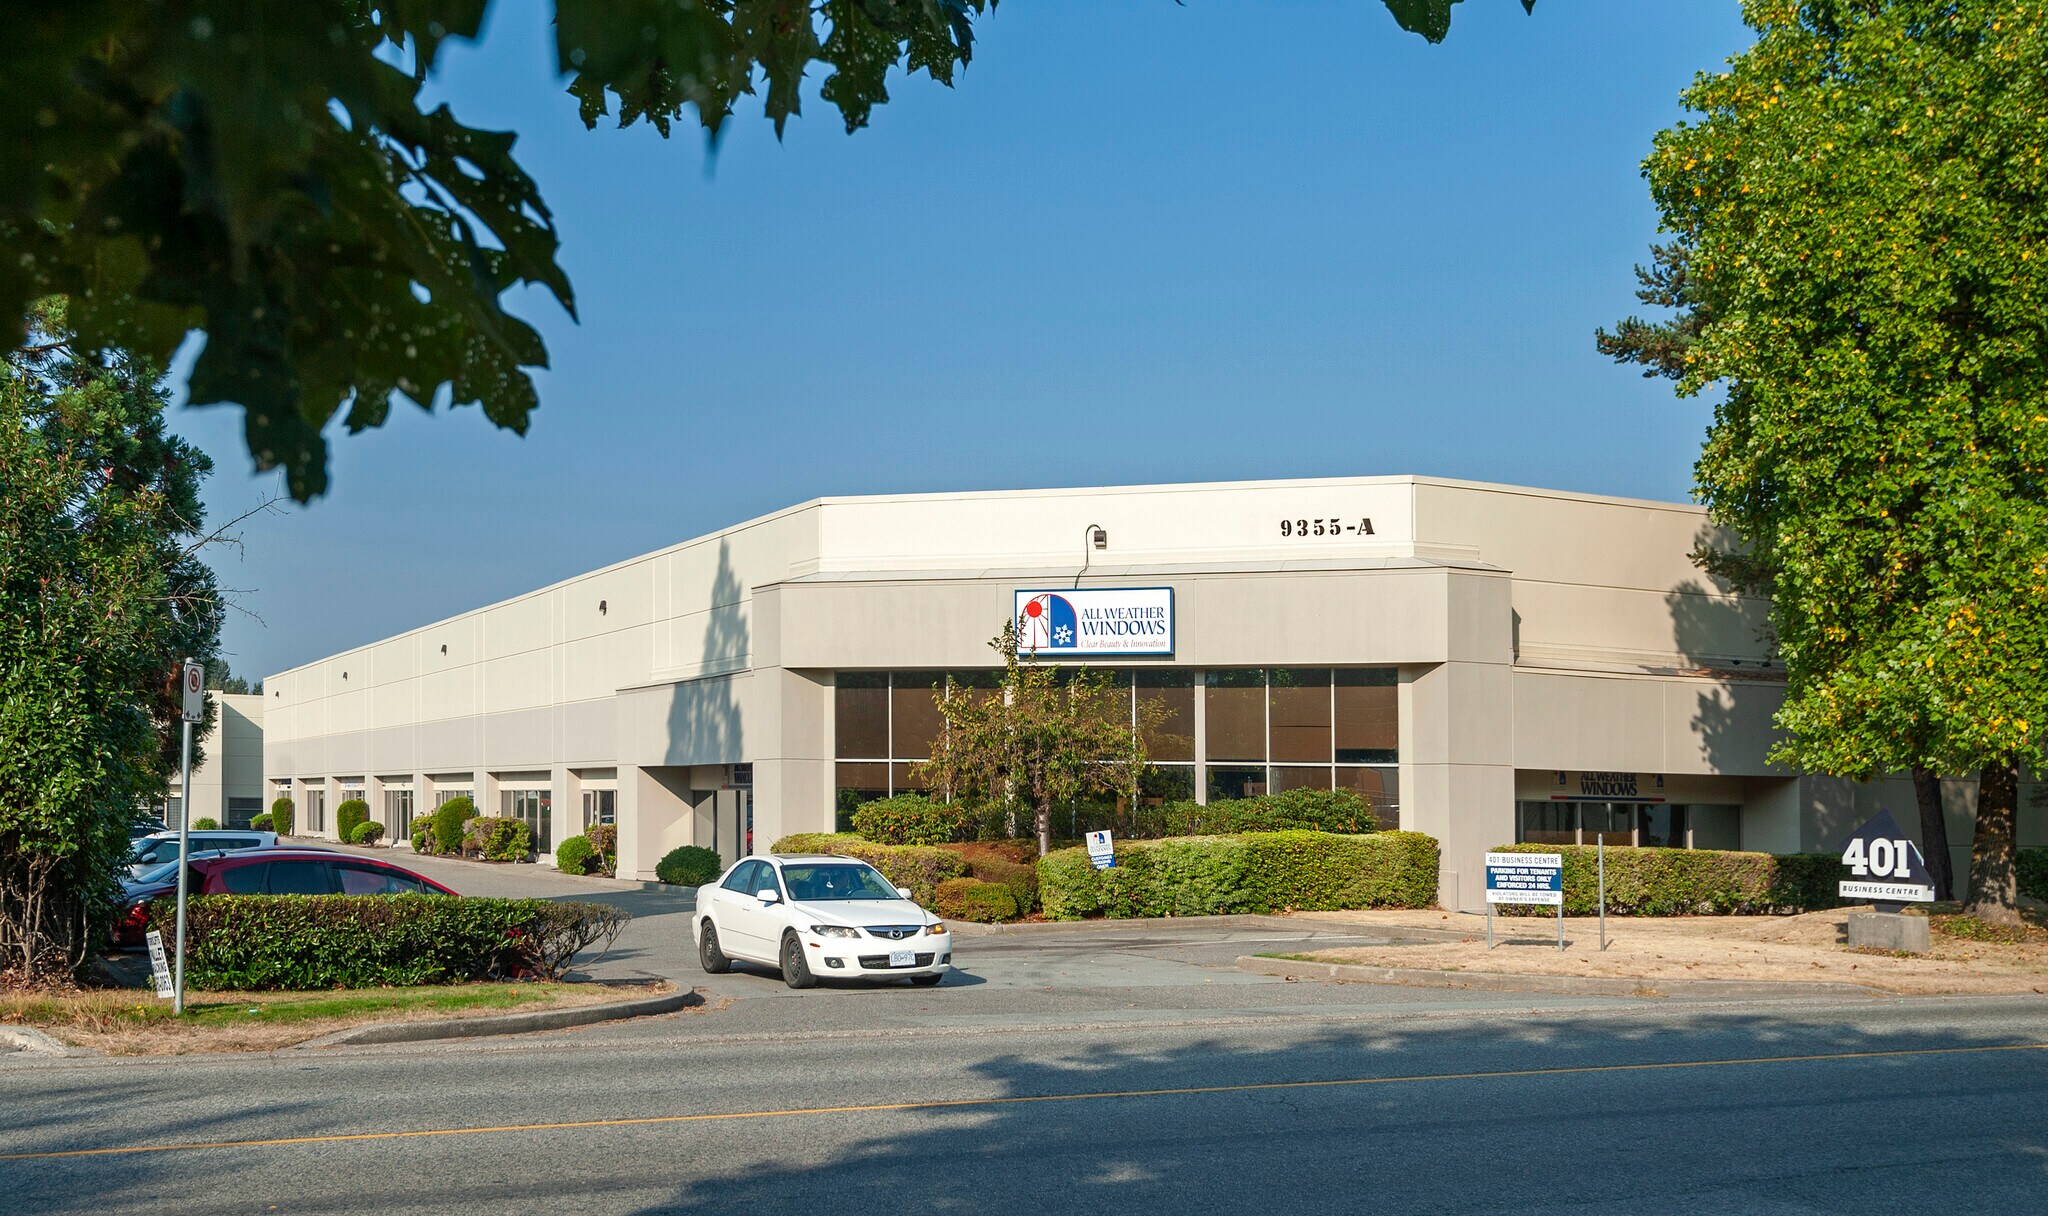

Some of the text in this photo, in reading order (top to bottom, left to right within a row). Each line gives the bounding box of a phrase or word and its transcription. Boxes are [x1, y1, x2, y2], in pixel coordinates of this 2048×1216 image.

[1280, 518, 1375, 537] 9355-A
[1081, 606, 1165, 620] ALL WEATHER
[1081, 620, 1166, 636] WINDOWS
[1080, 639, 1166, 649] Clear Beauty & Innovation
[1580, 772, 1637, 782] ALL WEATHER
[1580, 782, 1638, 796] WINDOWS
[1488, 856, 1558, 865] 401 BUSINESS CENTRE
[1841, 837, 1911, 878] 401
[1842, 885, 1919, 896] BUSINESS CENTRE
